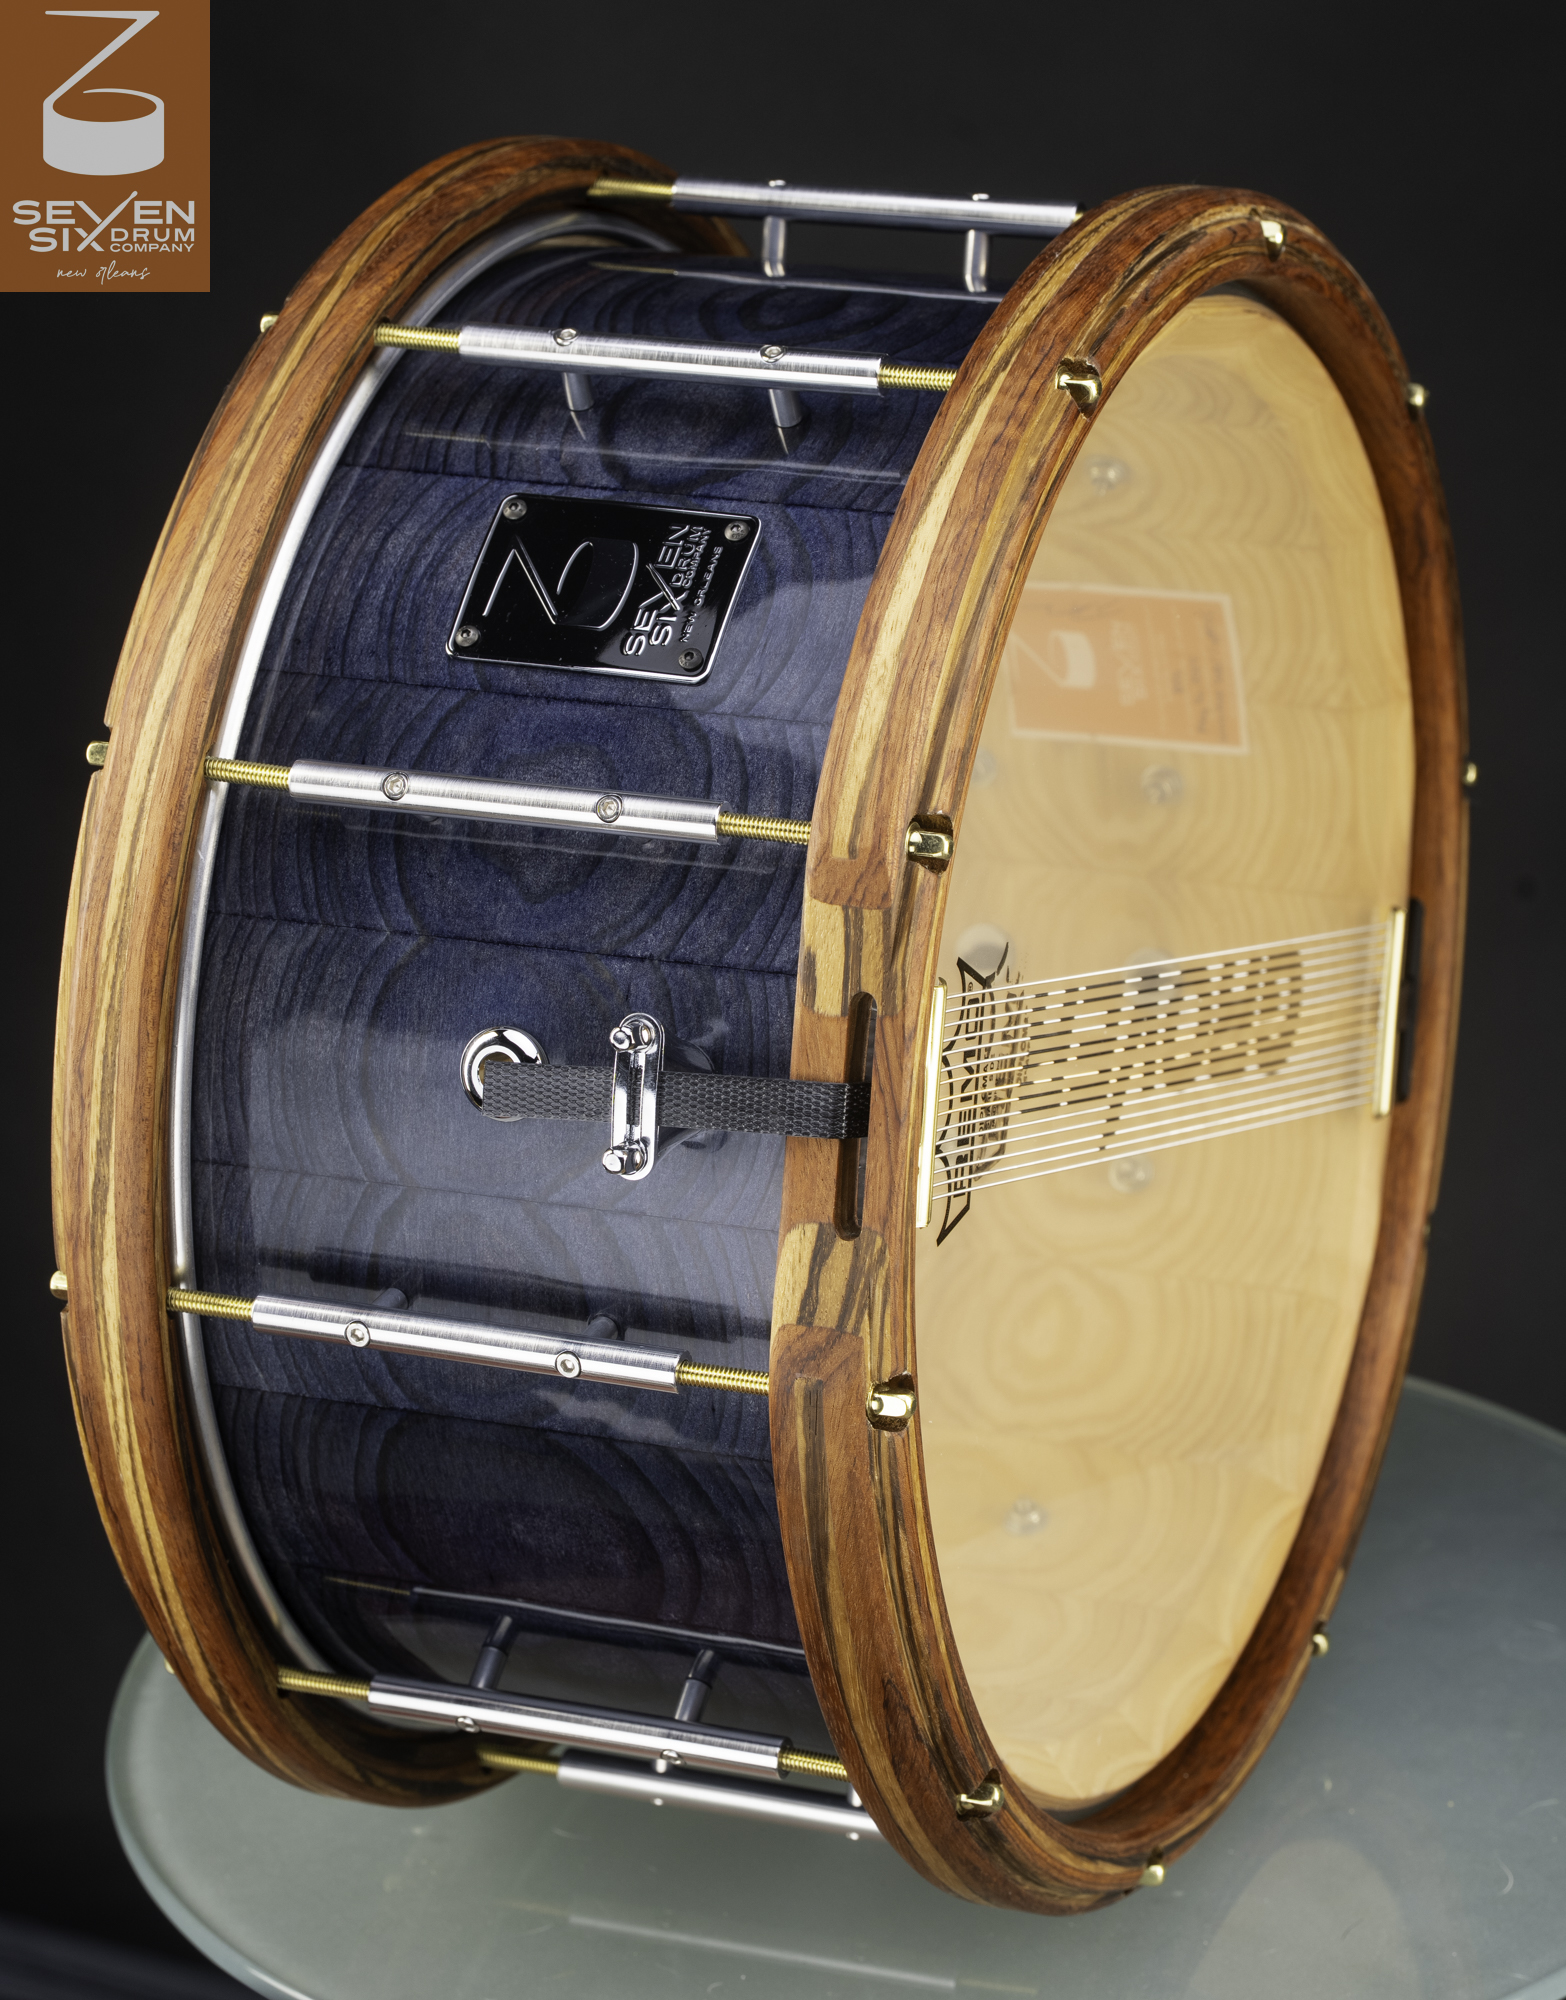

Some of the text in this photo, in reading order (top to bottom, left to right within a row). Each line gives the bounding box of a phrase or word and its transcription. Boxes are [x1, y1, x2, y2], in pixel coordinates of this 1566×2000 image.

[623, 524, 691, 656] SEVEN
[649, 526, 705, 646] SIX DRUM
[680, 612, 697, 643] NEW
[694, 546, 724, 607] ORLEANS
[682, 528, 712, 589] COMPANY
